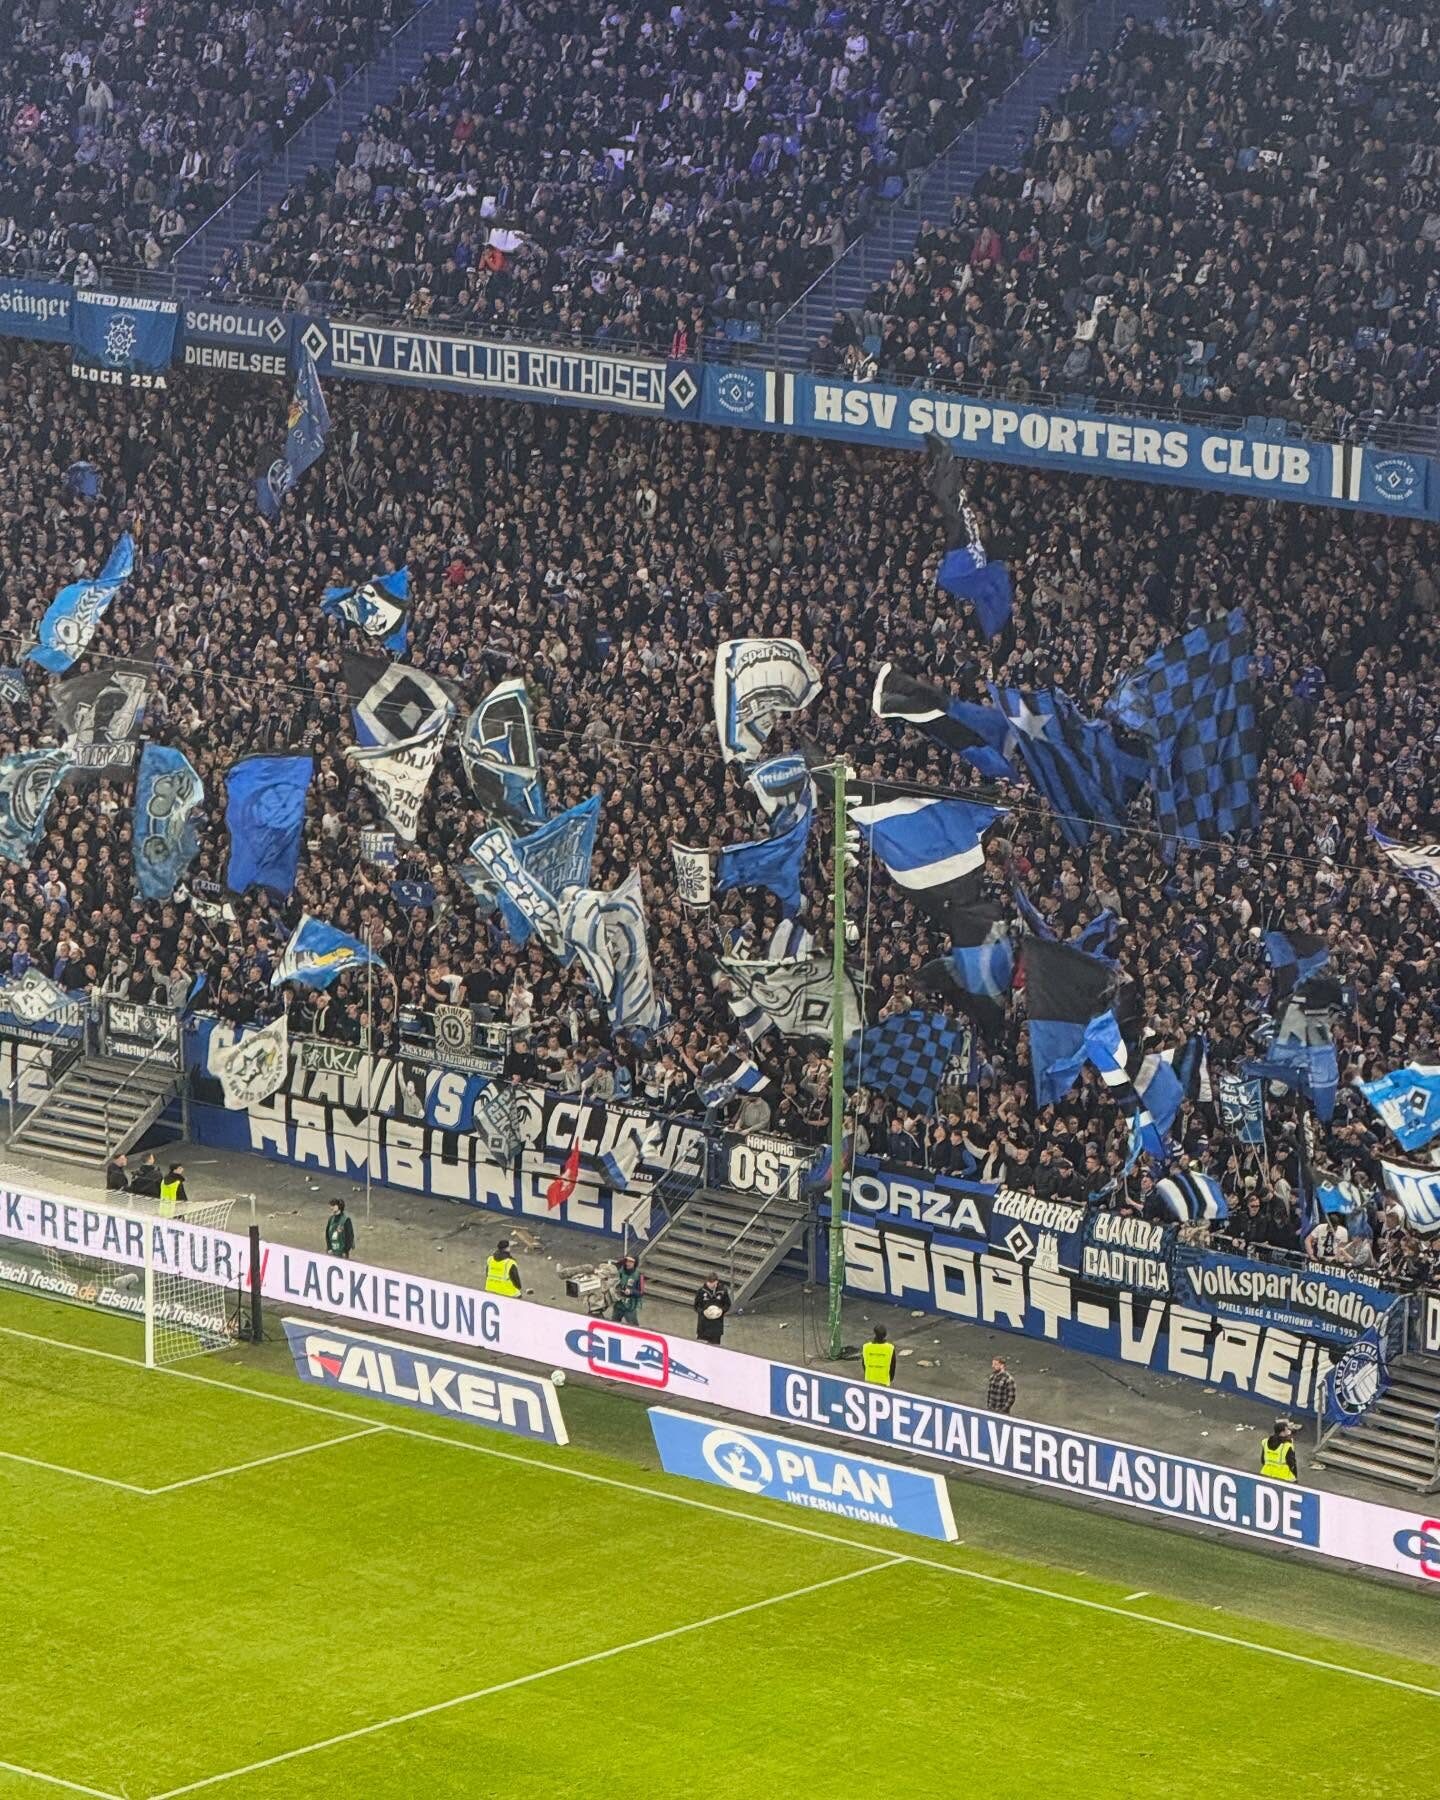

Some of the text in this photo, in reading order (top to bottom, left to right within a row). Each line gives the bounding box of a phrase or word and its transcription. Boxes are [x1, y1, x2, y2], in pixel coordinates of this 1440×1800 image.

[76, 291, 178, 314] UNITED FAMILY HH
[186, 311, 264, 337] SCHOLLI
[71, 364, 167, 389] BLOCK 23A
[185, 345, 286, 375] DIEMELSEE
[332, 328, 666, 403] HSV FAN CLUB ROTHOSEN
[814, 385, 1310, 485] HSV SUPPORTERS CLUB
[445, 1023, 461, 1041] 12
[604, 1103, 651, 1118] ULTRAS
[747, 1134, 794, 1157] HAMBURG
[729, 1144, 812, 1201] OST
[992, 1188, 1085, 1235] HAMBURG
[0, 1190, 233, 1282] K-REPARATUR
[1094, 1212, 1165, 1254] BANDA
[1083, 1246, 1170, 1293] CAOTICA
[1308, 1262, 1381, 1289] HOLSTEN CREW
[283, 1254, 500, 1343] LACKIERUNG
[1217, 1301, 1243, 1315] SPIELE,
[1244, 1306, 1264, 1318] SIEGE
[1321, 1323, 1337, 1334] SEIT
[785, 1372, 1304, 1539] GL-SPEZIALVERGLASUNG.DE
[776, 1449, 893, 1509] PLAN
[786, 1490, 898, 1528] INTERNATIONAL
